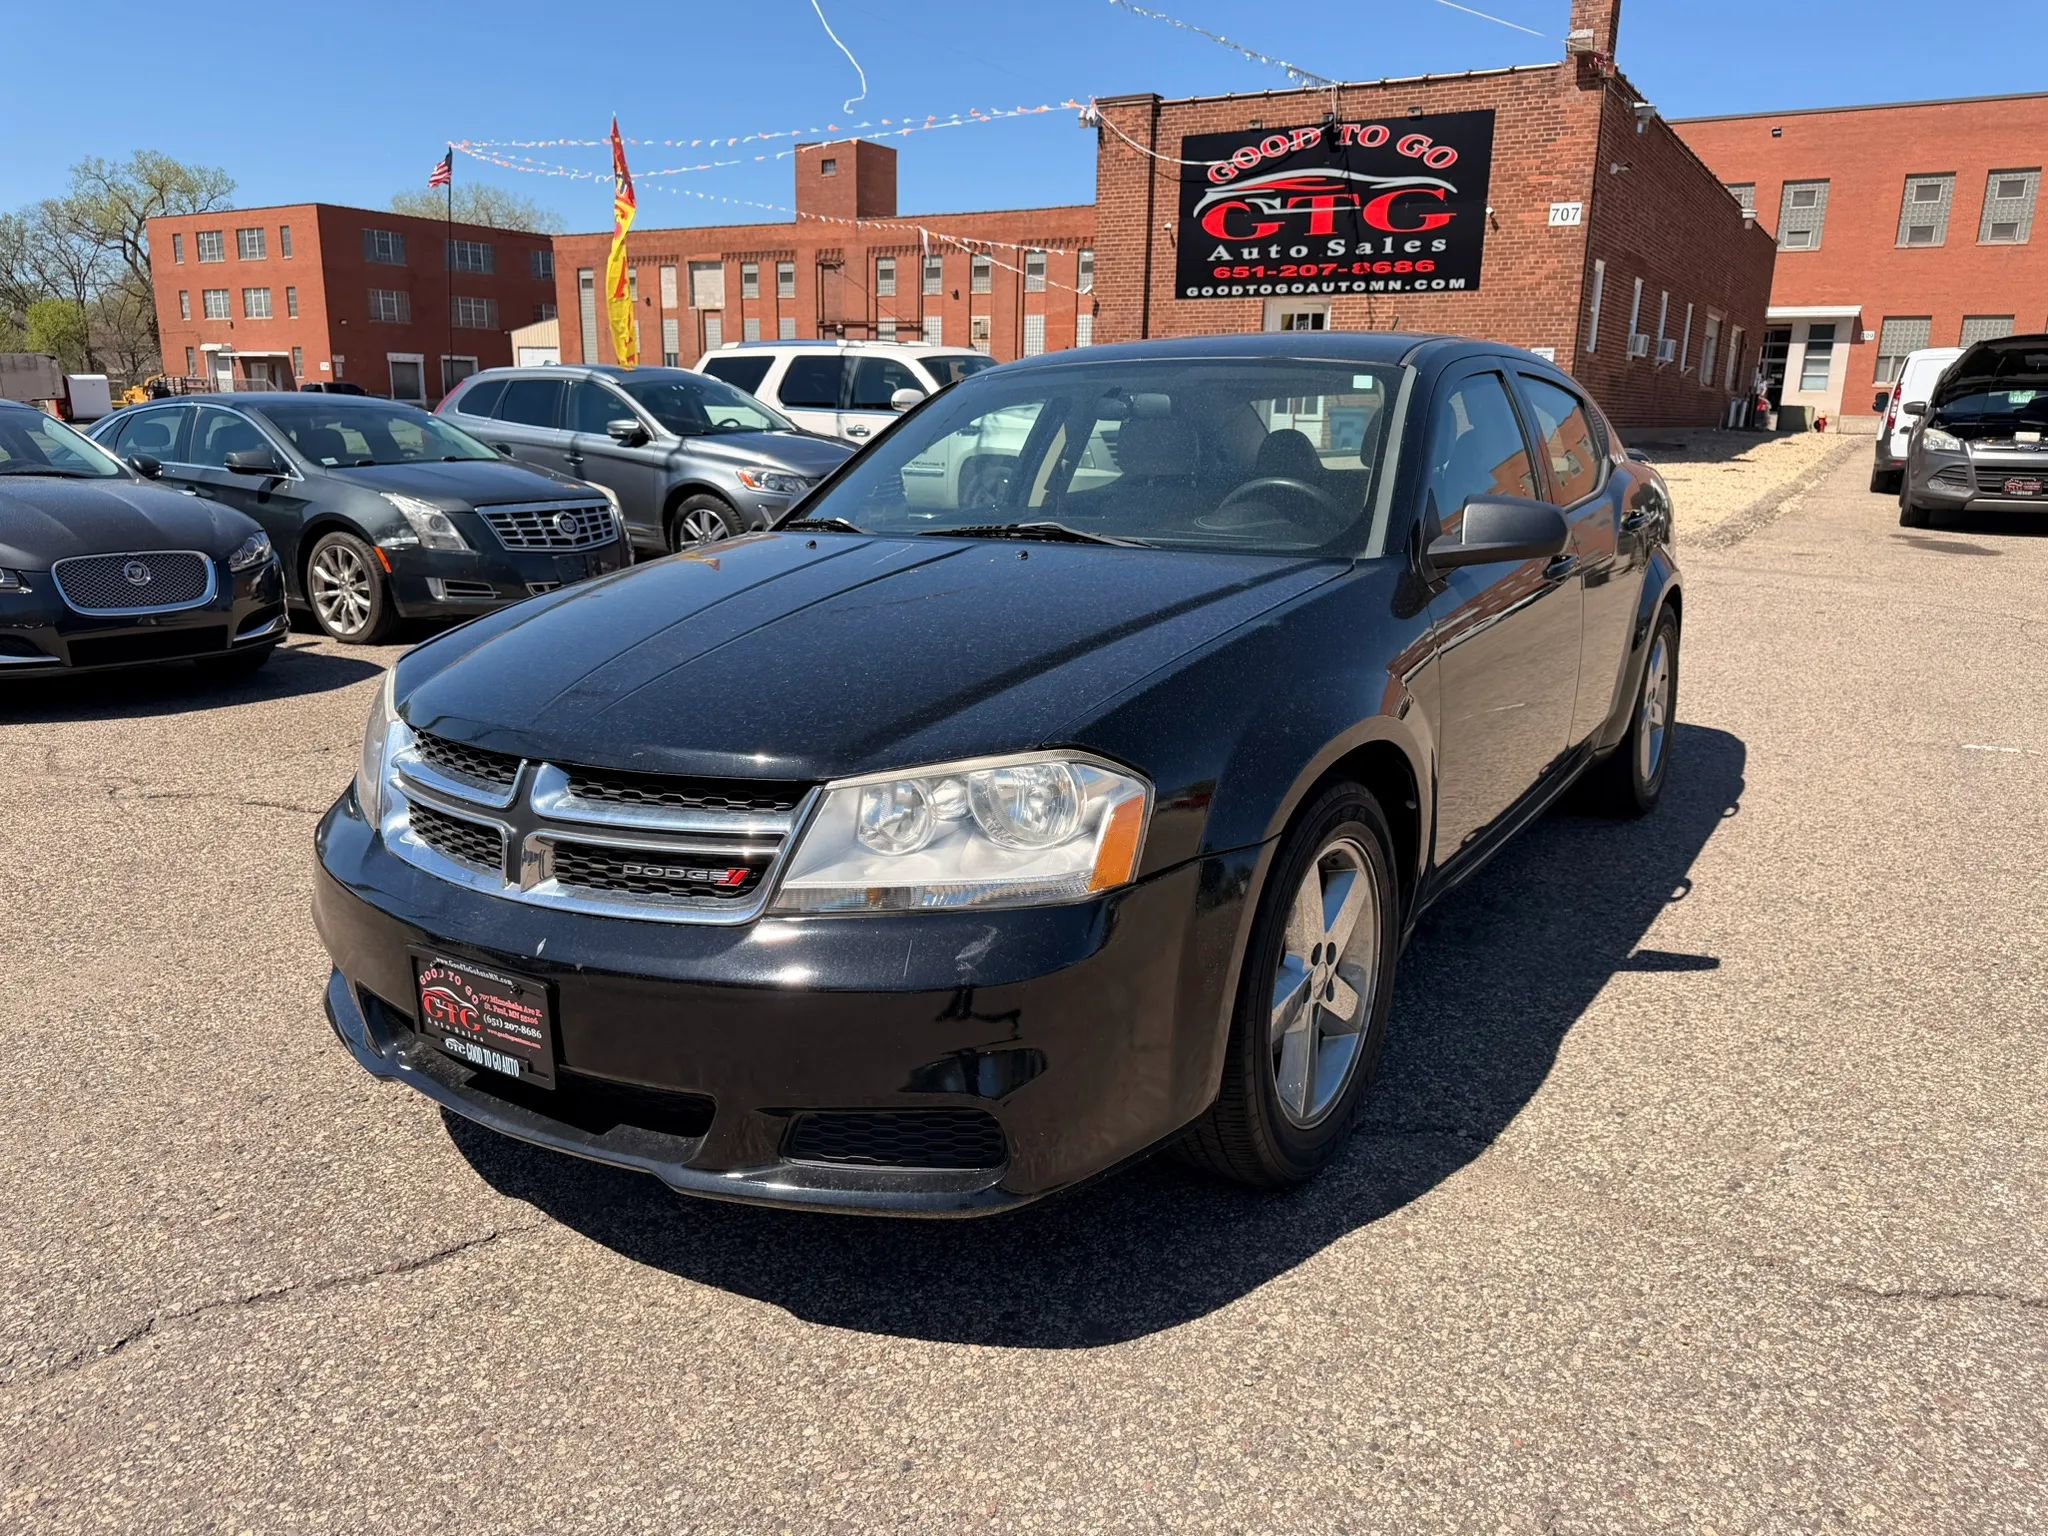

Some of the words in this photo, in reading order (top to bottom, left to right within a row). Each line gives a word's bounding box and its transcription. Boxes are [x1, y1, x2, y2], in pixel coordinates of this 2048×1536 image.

[1207, 127, 1322, 184] GOOD
[1336, 123, 1390, 148] TO
[1396, 133, 1458, 169] GO
[1201, 188, 1457, 240] GTG
[1551, 207, 1580, 222] 707
[1207, 243, 1308, 262] Auto
[1327, 236, 1448, 257] Sales
[1213, 259, 1435, 279] 651-207-8686
[1186, 277, 1466, 297] GOODTOGOAUTOMN.COM
[623, 864, 730, 882] DODGE
[447, 970, 462, 986] TO
[483, 1013, 503, 1028] (651)
[504, 1021, 542, 1039] 207-8686
[465, 1043, 483, 1065] GOOD
[483, 1049, 492, 1068] TO
[492, 1052, 502, 1071] GO
[502, 1056, 520, 1078] AUTO
